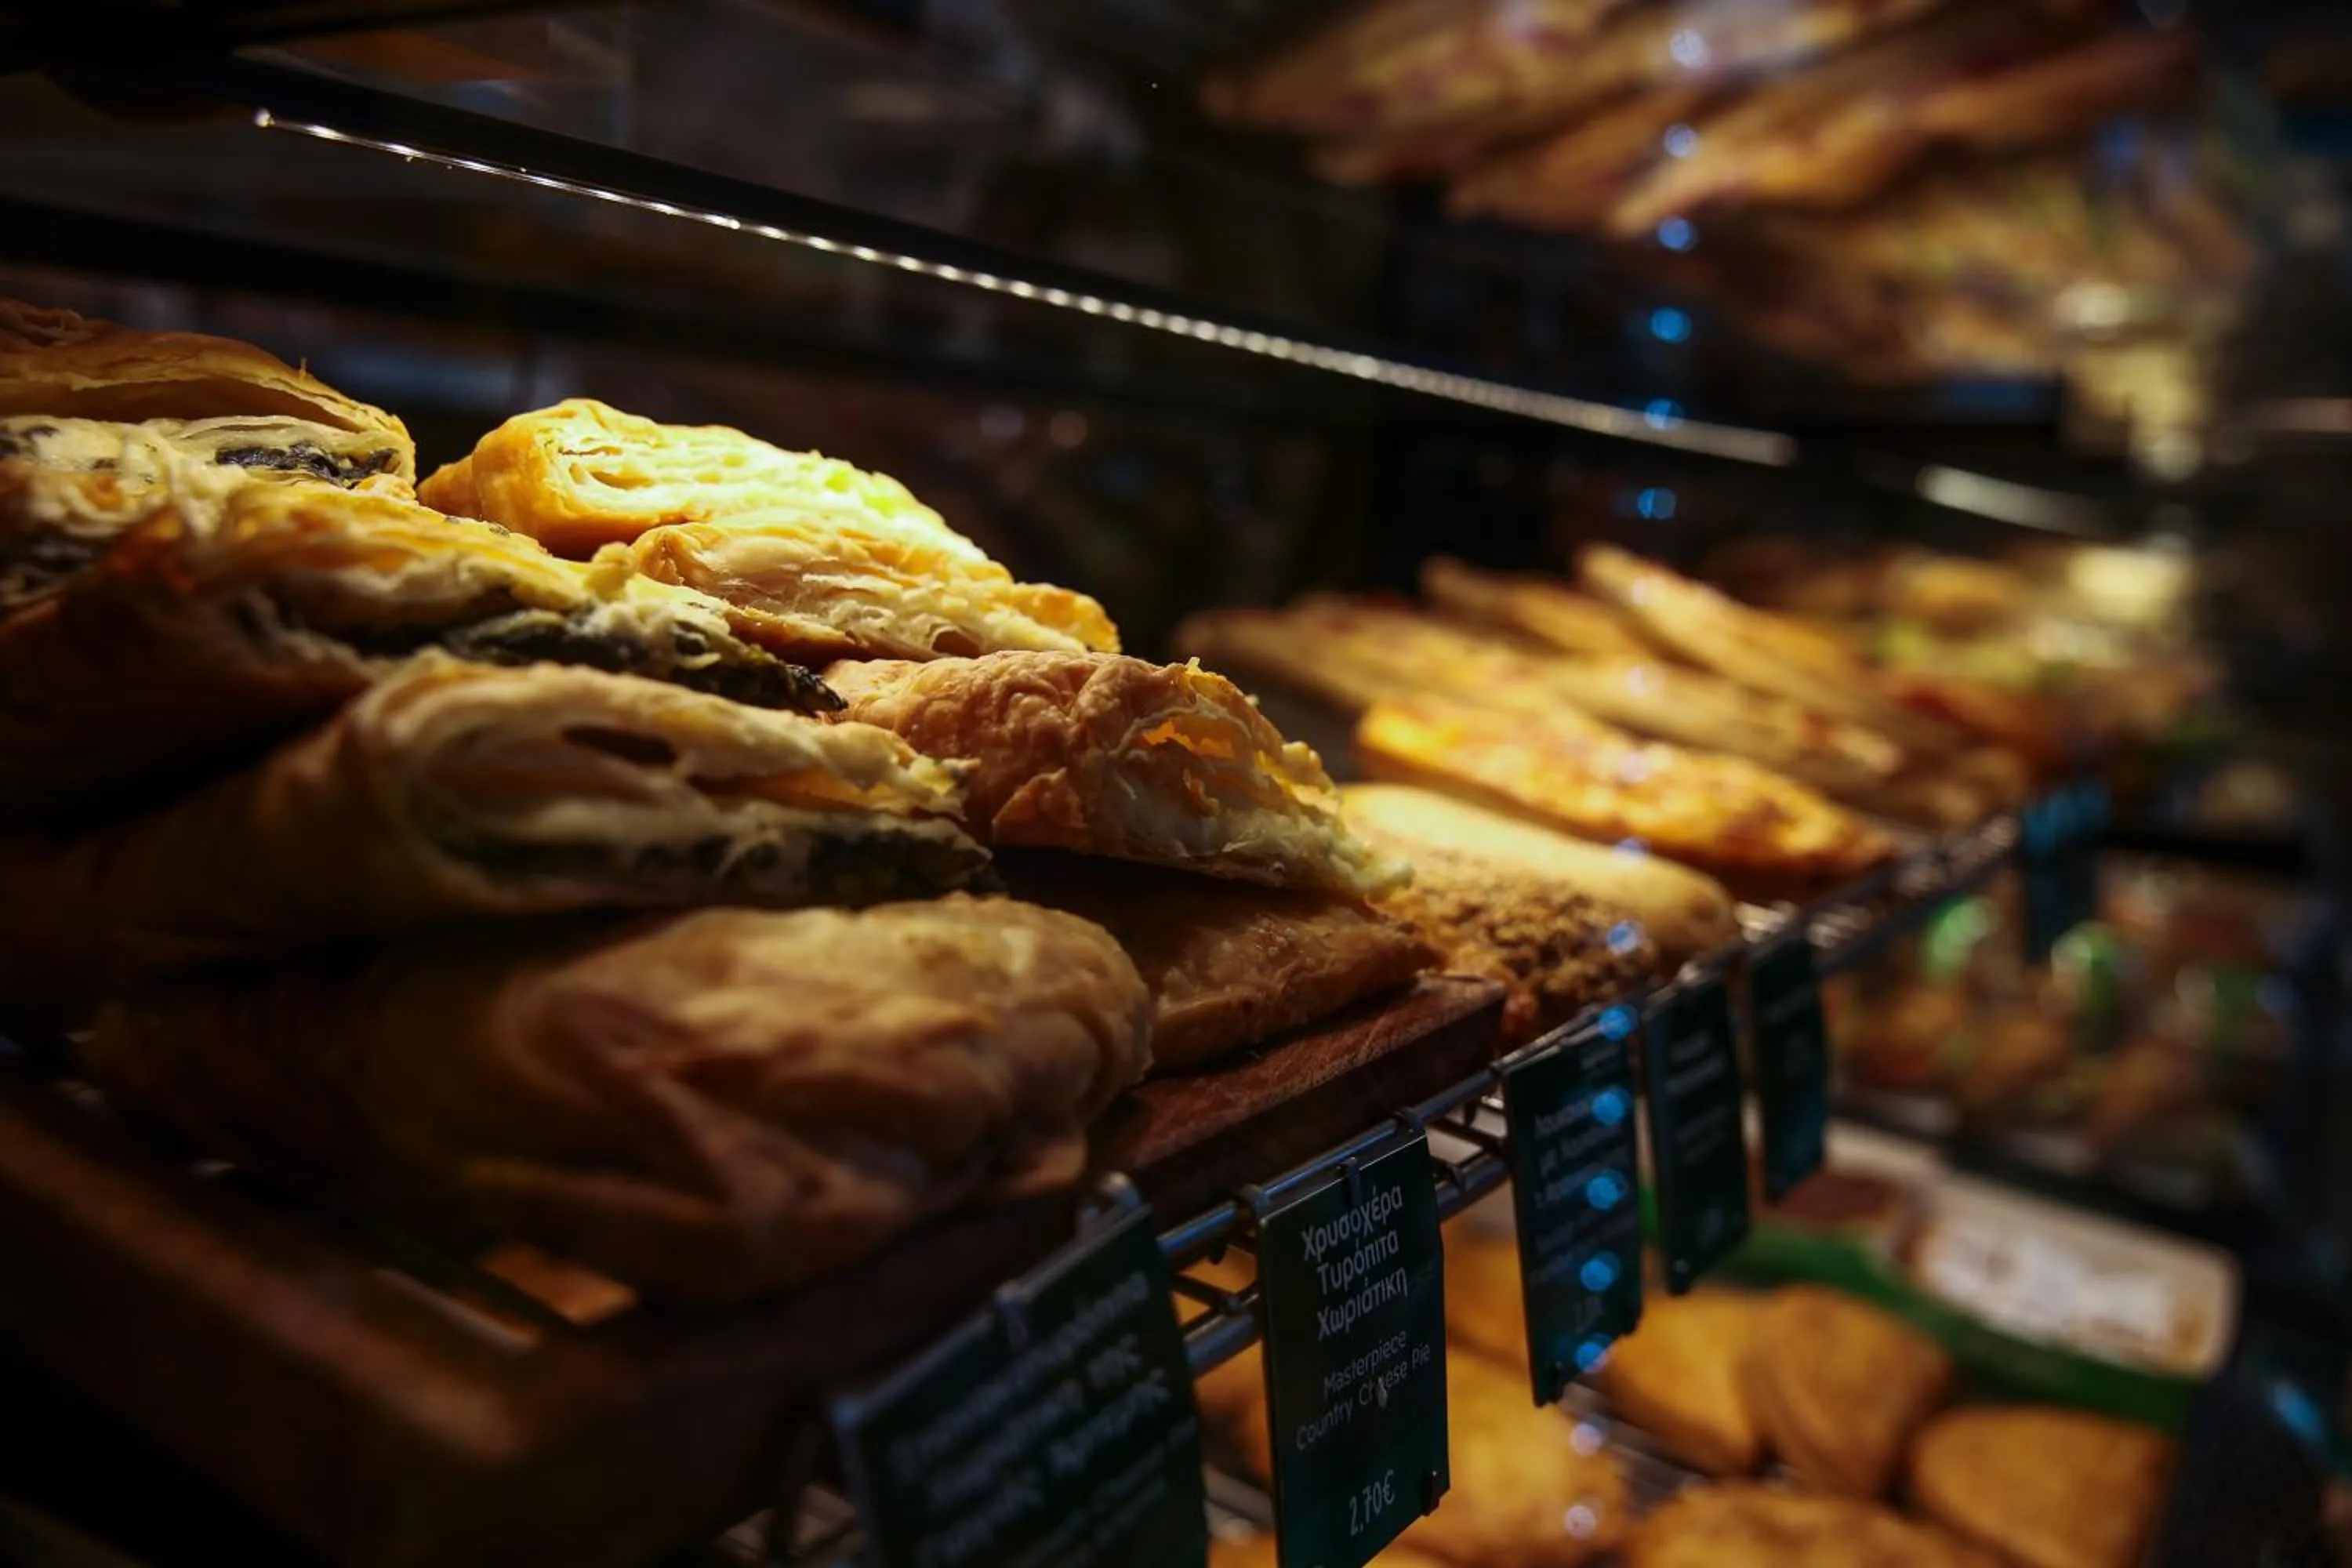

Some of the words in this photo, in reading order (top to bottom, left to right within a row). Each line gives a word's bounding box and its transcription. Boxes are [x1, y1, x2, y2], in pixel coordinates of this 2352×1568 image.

[1301, 1184, 1403, 1262] Χρυσοχέρα
[1317, 1229, 1400, 1295] Τυρόπιτα
[1316, 1266, 1408, 1343] Χωριάτικη
[1323, 1330, 1406, 1400] Masterpiece
[1296, 1397, 1354, 1451] Country
[1359, 1360, 1408, 1406] Chese
[1348, 1468, 1396, 1537] 2,70€
